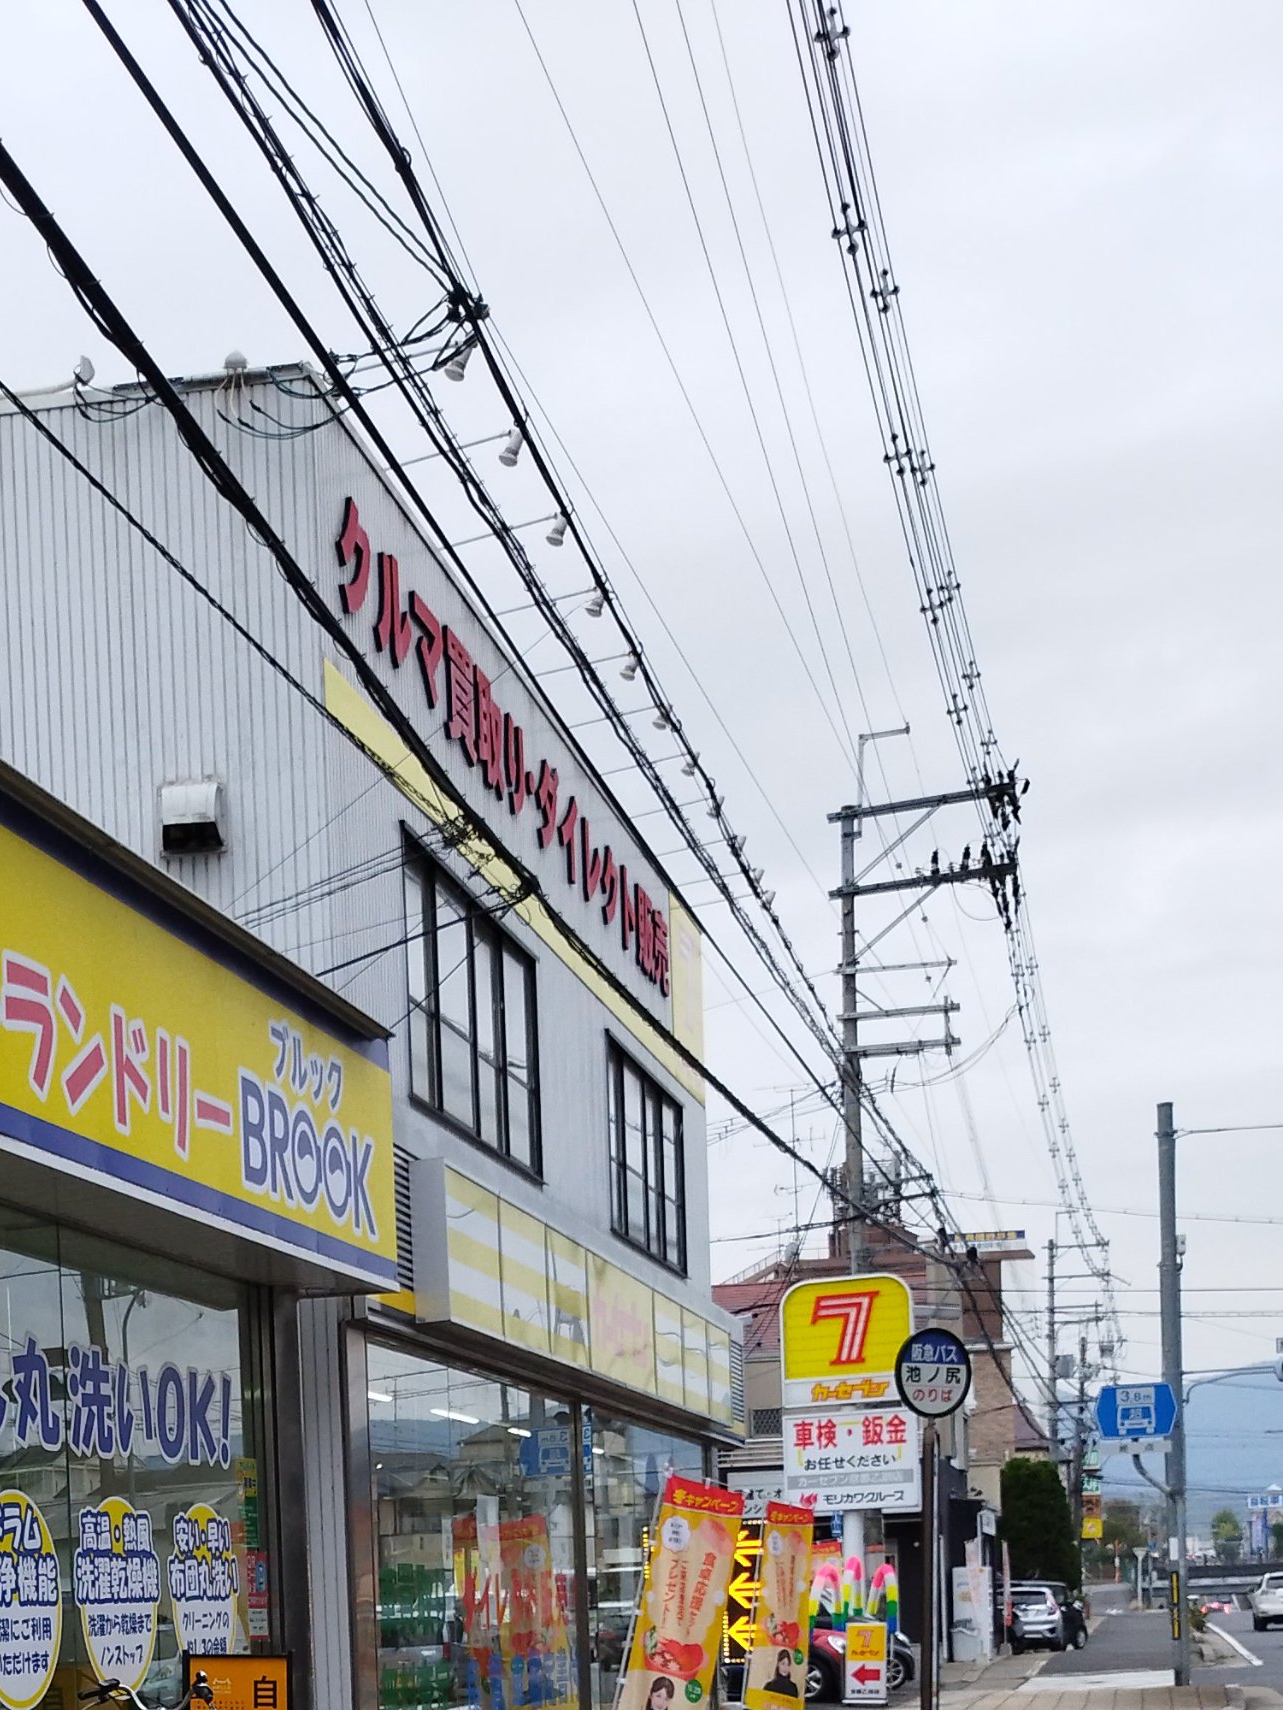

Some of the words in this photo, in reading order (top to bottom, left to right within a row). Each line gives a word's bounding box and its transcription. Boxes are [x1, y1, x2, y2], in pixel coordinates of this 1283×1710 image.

[270, 1023, 343, 1106] ブルック
[240, 1074, 378, 1234] BROOK
[811, 1290, 880, 1366] 7
[910, 1343, 959, 1363] 阪急バス
[811, 1378, 890, 1402] カーセブン
[905, 1366, 961, 1385] 池ノ尻
[912, 1388, 953, 1402] のりば
[792, 1413, 908, 1450] 車検・鈑金
[804, 1453, 897, 1471] お任せください
[82, 1514, 150, 1551] 高温・熱風
[175, 1518, 230, 1552] 安い・早い
[77, 1556, 159, 1601] 洗濯乾燥機
[170, 1557, 238, 1599] 布団丸洗い
[182, 1611, 230, 1632] クリーニングの
[100, 1643, 144, 1667] ノンストップ
